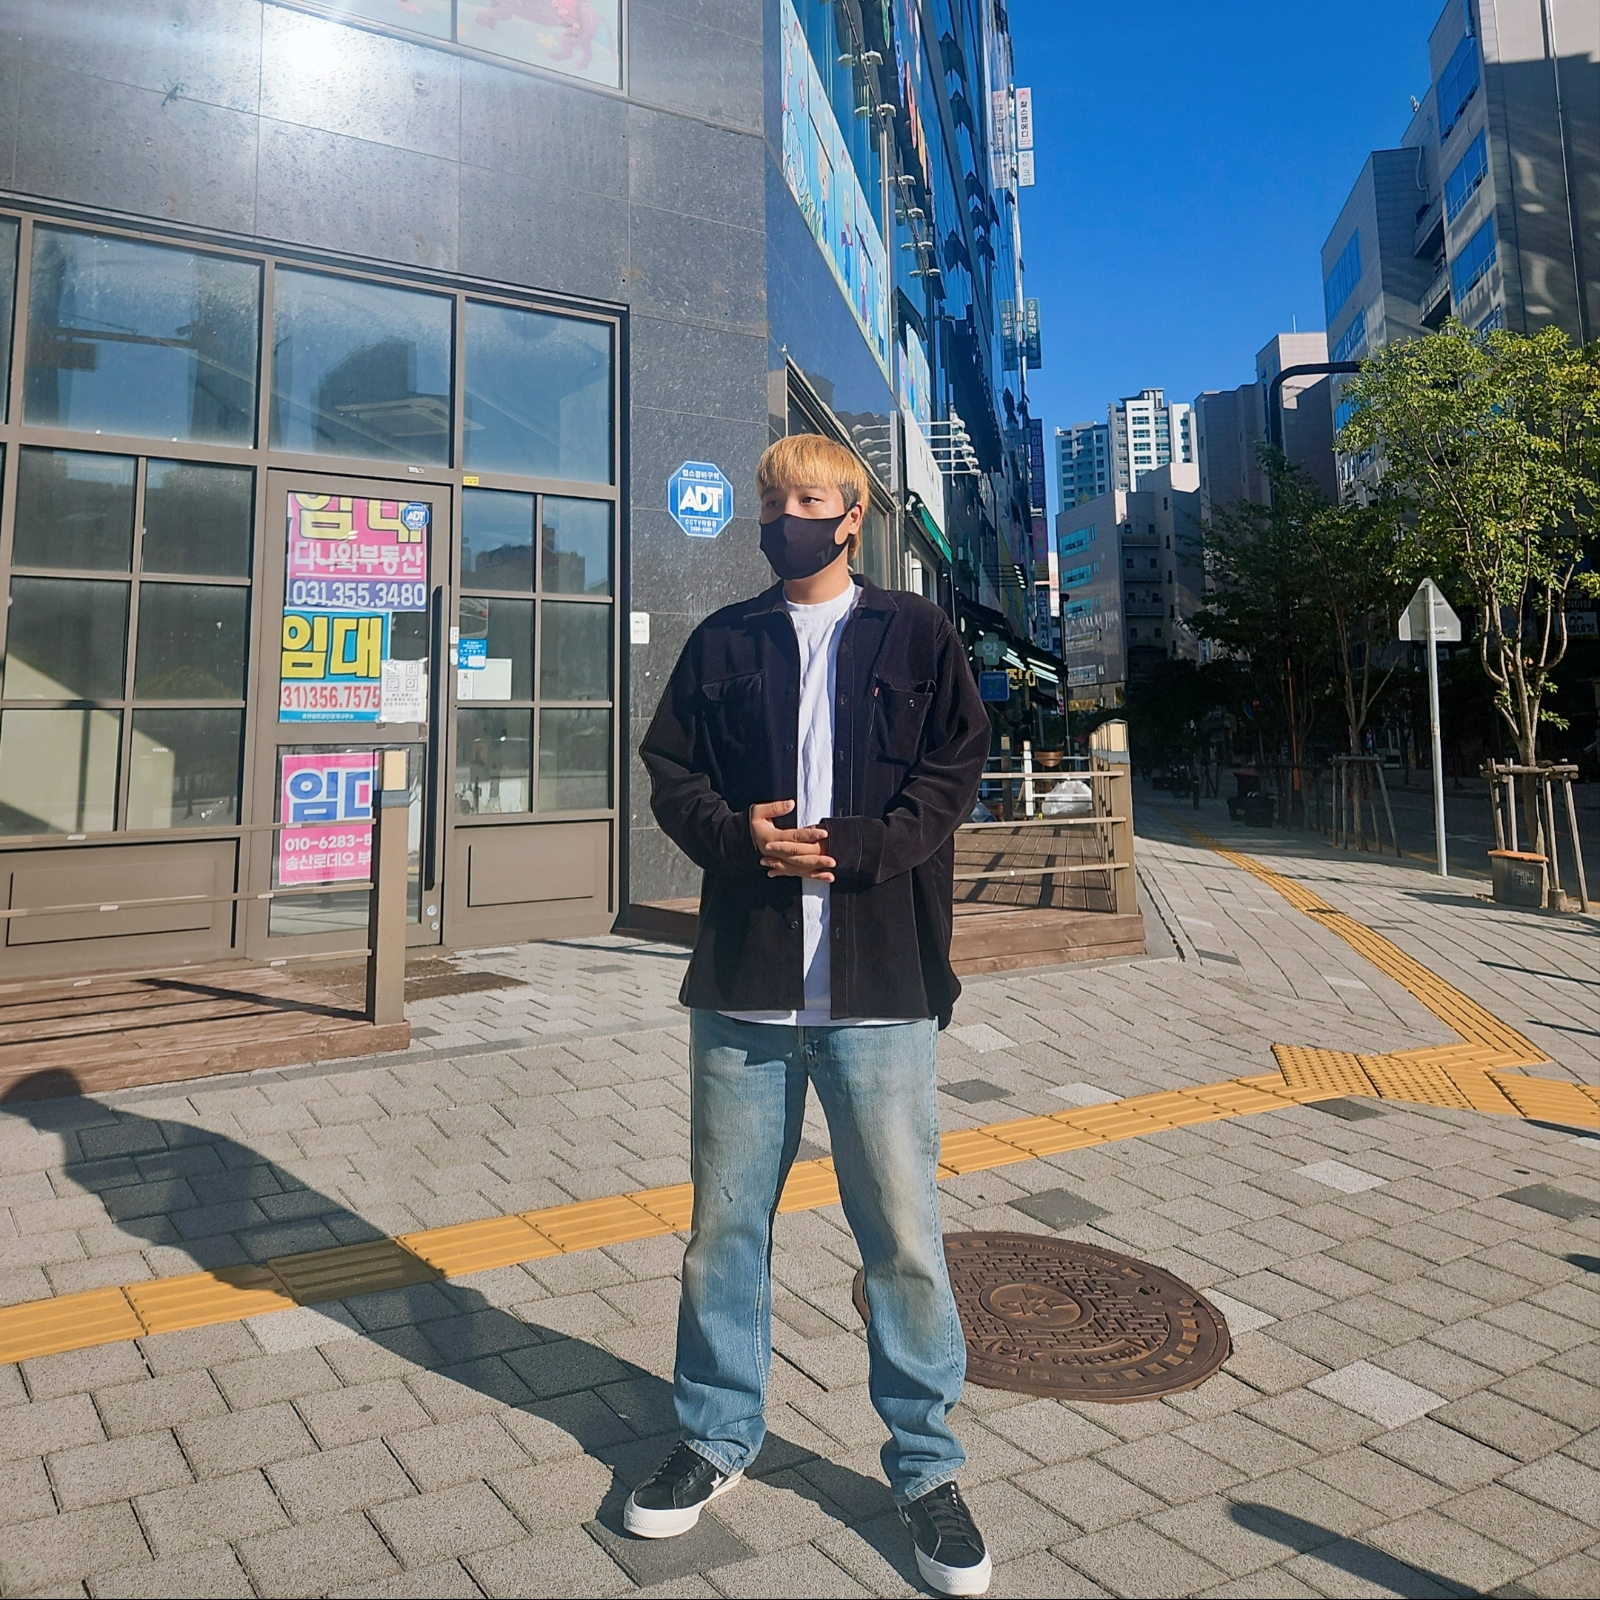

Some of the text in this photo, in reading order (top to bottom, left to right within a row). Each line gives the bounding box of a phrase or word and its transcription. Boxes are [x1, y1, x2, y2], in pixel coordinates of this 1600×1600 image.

[680, 485, 723, 513] ADT
[406, 511, 425, 522] ADT
[293, 541, 424, 575] 다나와부동산
[292, 581, 426, 607] 031.355.3480
[281, 614, 383, 680] 임대
[982, 642, 999, 659] 약
[280, 685, 380, 711] 31)356.7575
[285, 852, 355, 871] 송산로데오
[1050, 1346, 1143, 1366] telecom
